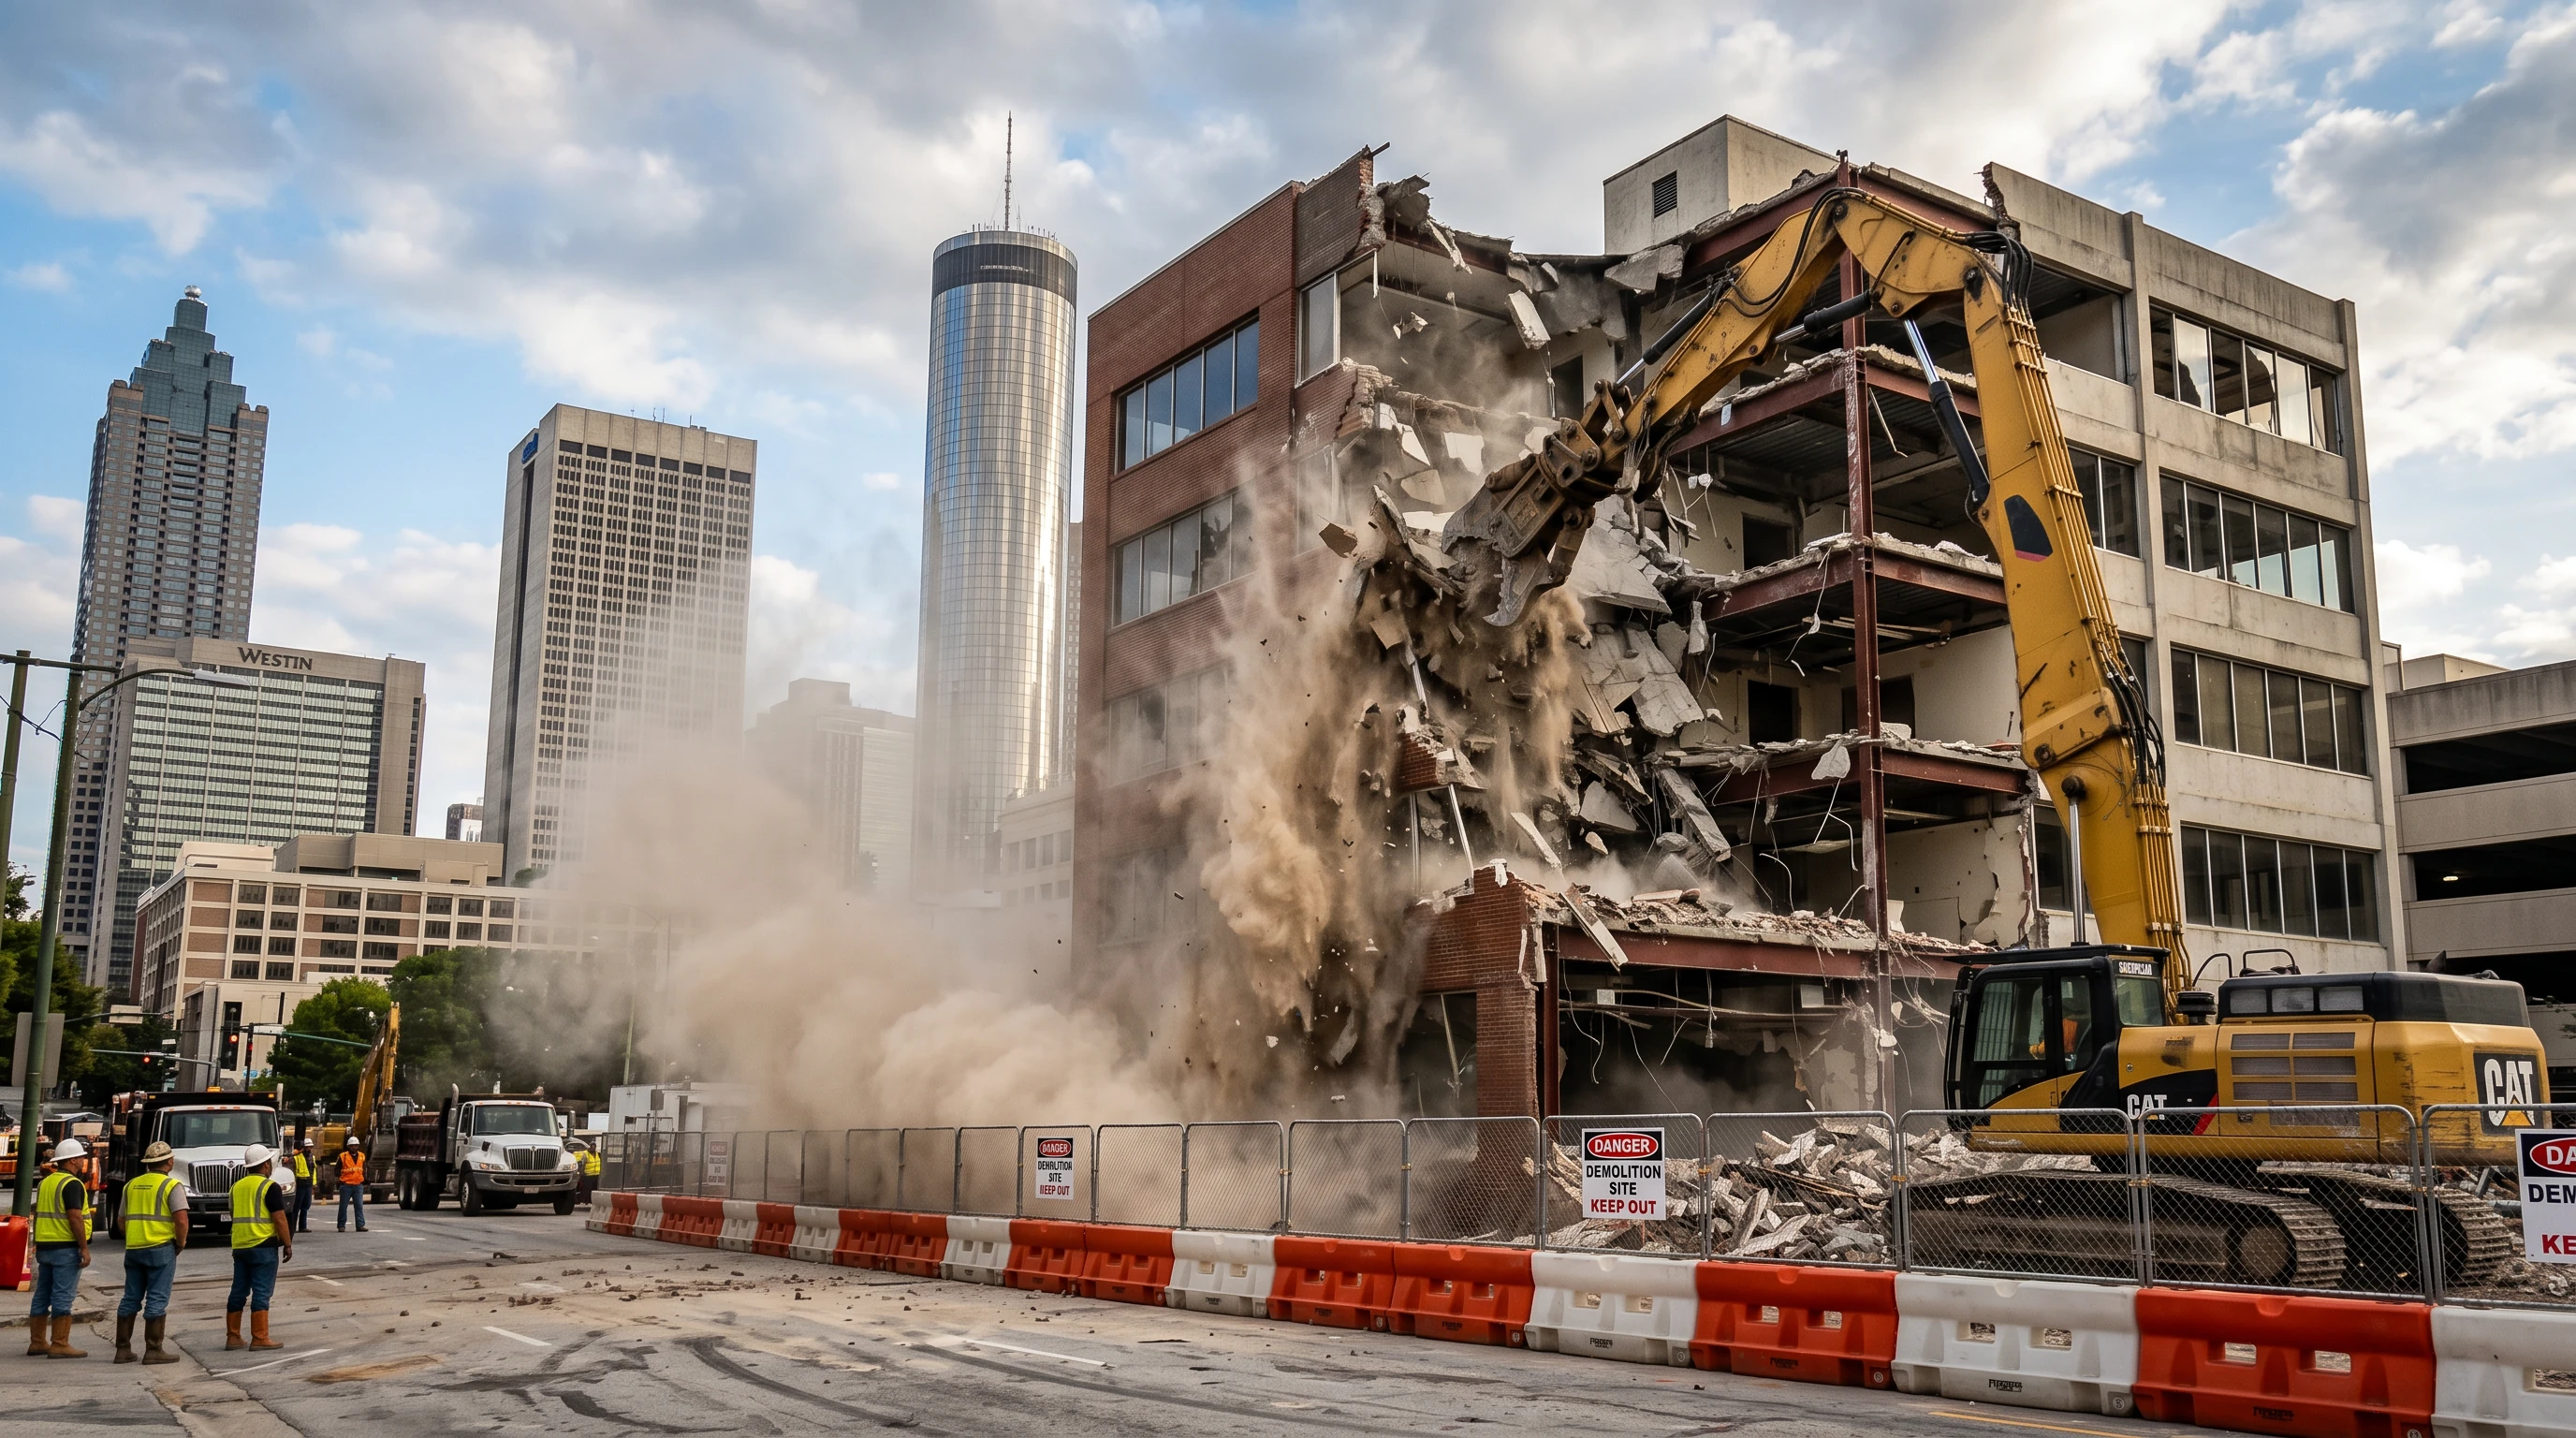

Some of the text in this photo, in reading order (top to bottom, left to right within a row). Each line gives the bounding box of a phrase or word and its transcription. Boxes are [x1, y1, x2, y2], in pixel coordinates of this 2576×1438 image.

[237, 646, 313, 670] WESTIN
[2484, 1058, 2535, 1126] CAT
[2127, 1093, 2168, 1121] CAT
[1594, 1138, 1650, 1153] DANGER
[1048, 1173, 1061, 1182] SITE
[1586, 1165, 1661, 1179] DEMOLITION
[1057, 1185, 1070, 1196] OUT
[1609, 1181, 1637, 1196] SITE
[1590, 1198, 1657, 1214] KEEP OUT
